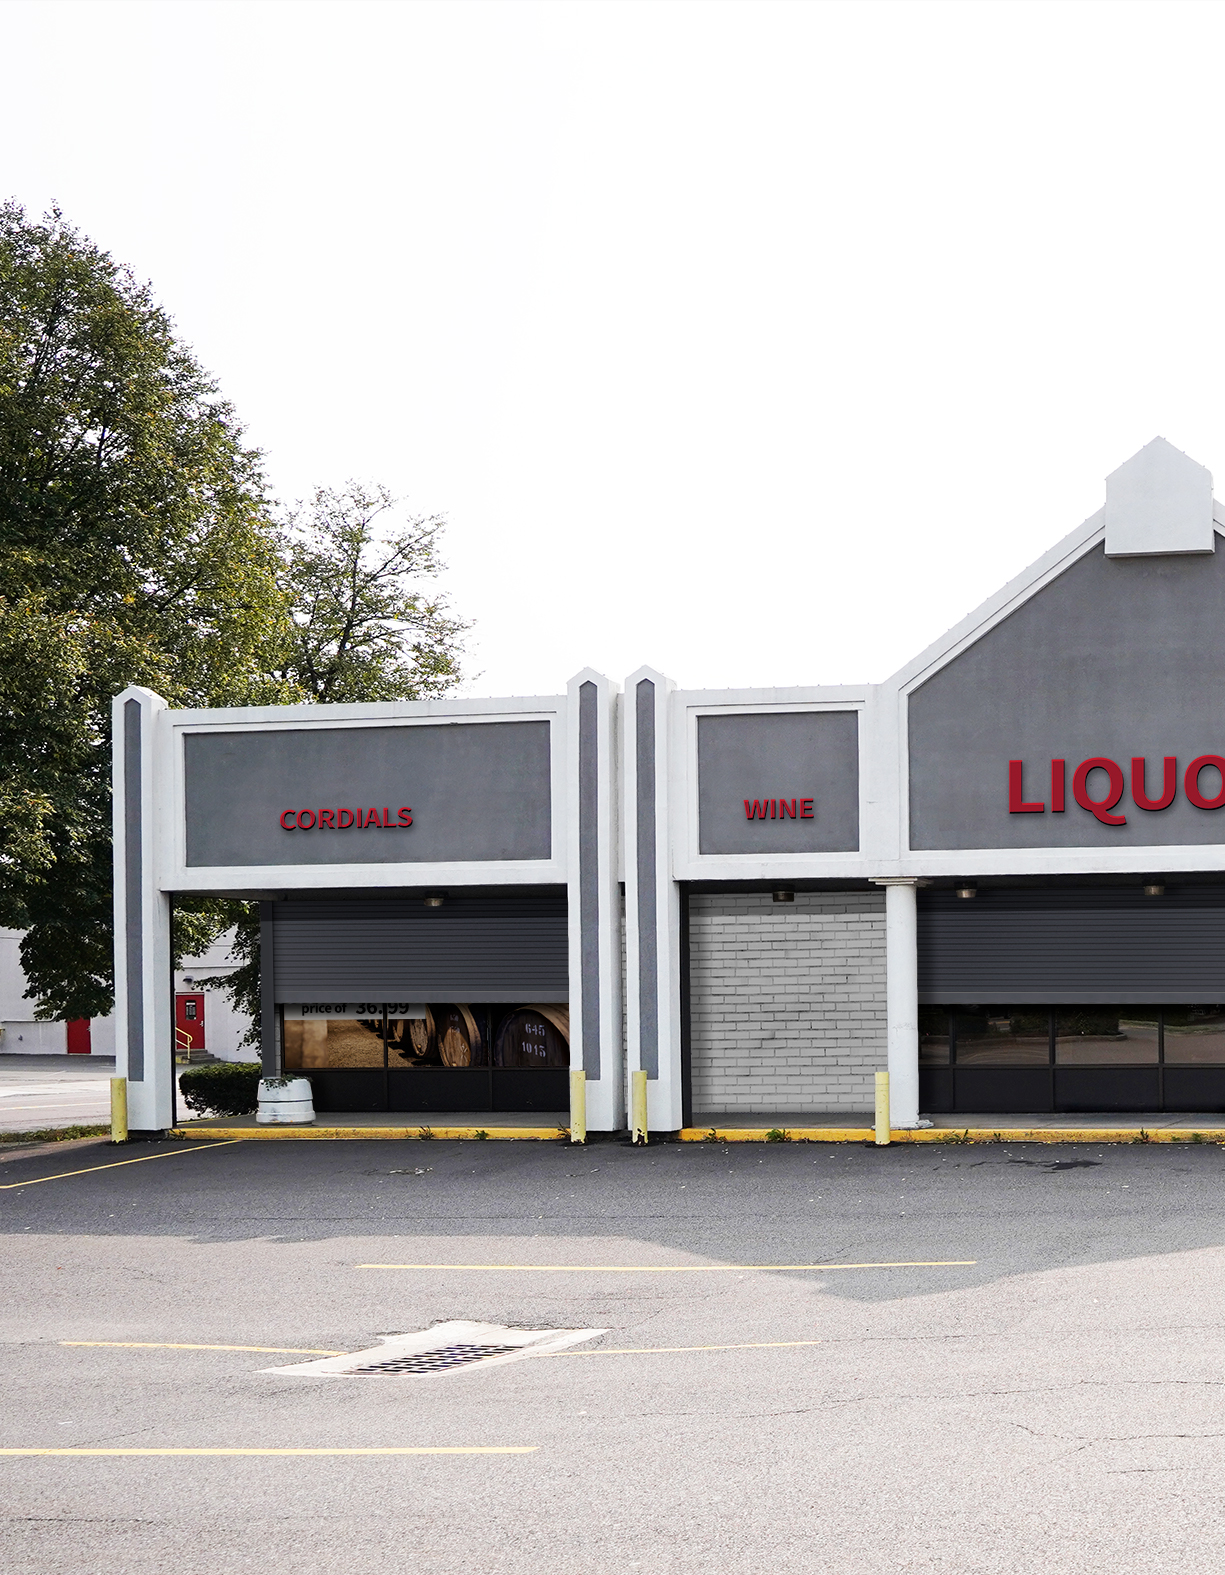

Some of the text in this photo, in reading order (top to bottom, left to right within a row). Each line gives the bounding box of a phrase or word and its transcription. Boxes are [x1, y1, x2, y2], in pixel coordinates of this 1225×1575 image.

[744, 798, 815, 820] WINE
[280, 807, 414, 830] CORDIALS
[302, 1003, 332, 1016] price
[334, 1003, 347, 1014] of
[525, 1023, 546, 1037] 645
